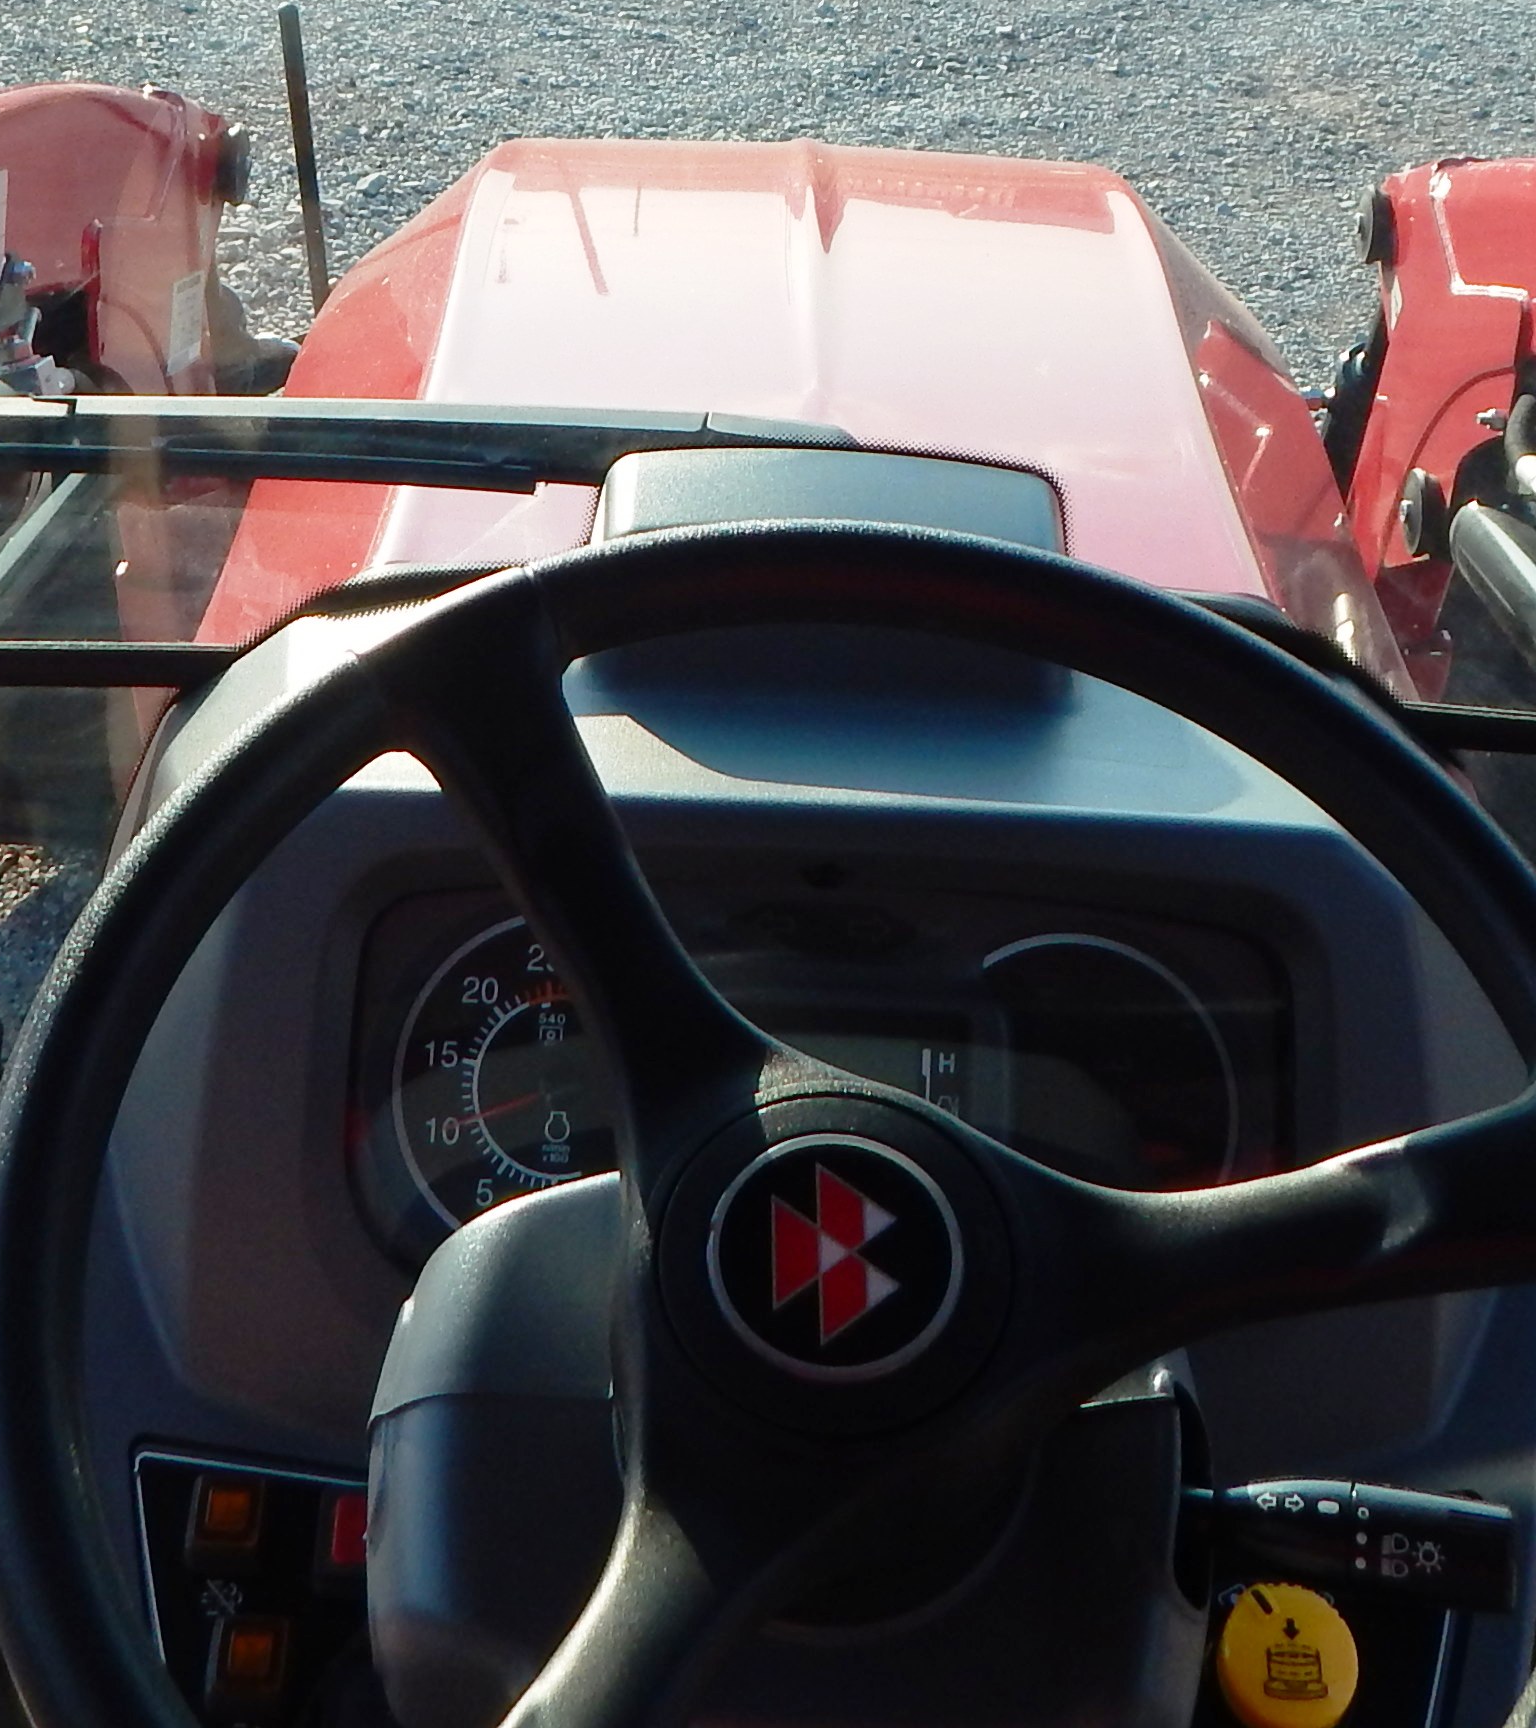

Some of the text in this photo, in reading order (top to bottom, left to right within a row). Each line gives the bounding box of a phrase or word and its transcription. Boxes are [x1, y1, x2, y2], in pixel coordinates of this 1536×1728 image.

[527, 943, 555, 972] 2
[461, 976, 499, 1005] 20
[538, 1012, 567, 1025] 540
[425, 1040, 459, 1069] 15
[938, 1051, 956, 1074] H
[425, 1117, 460, 1146] 10
[475, 1178, 494, 1207] 5
